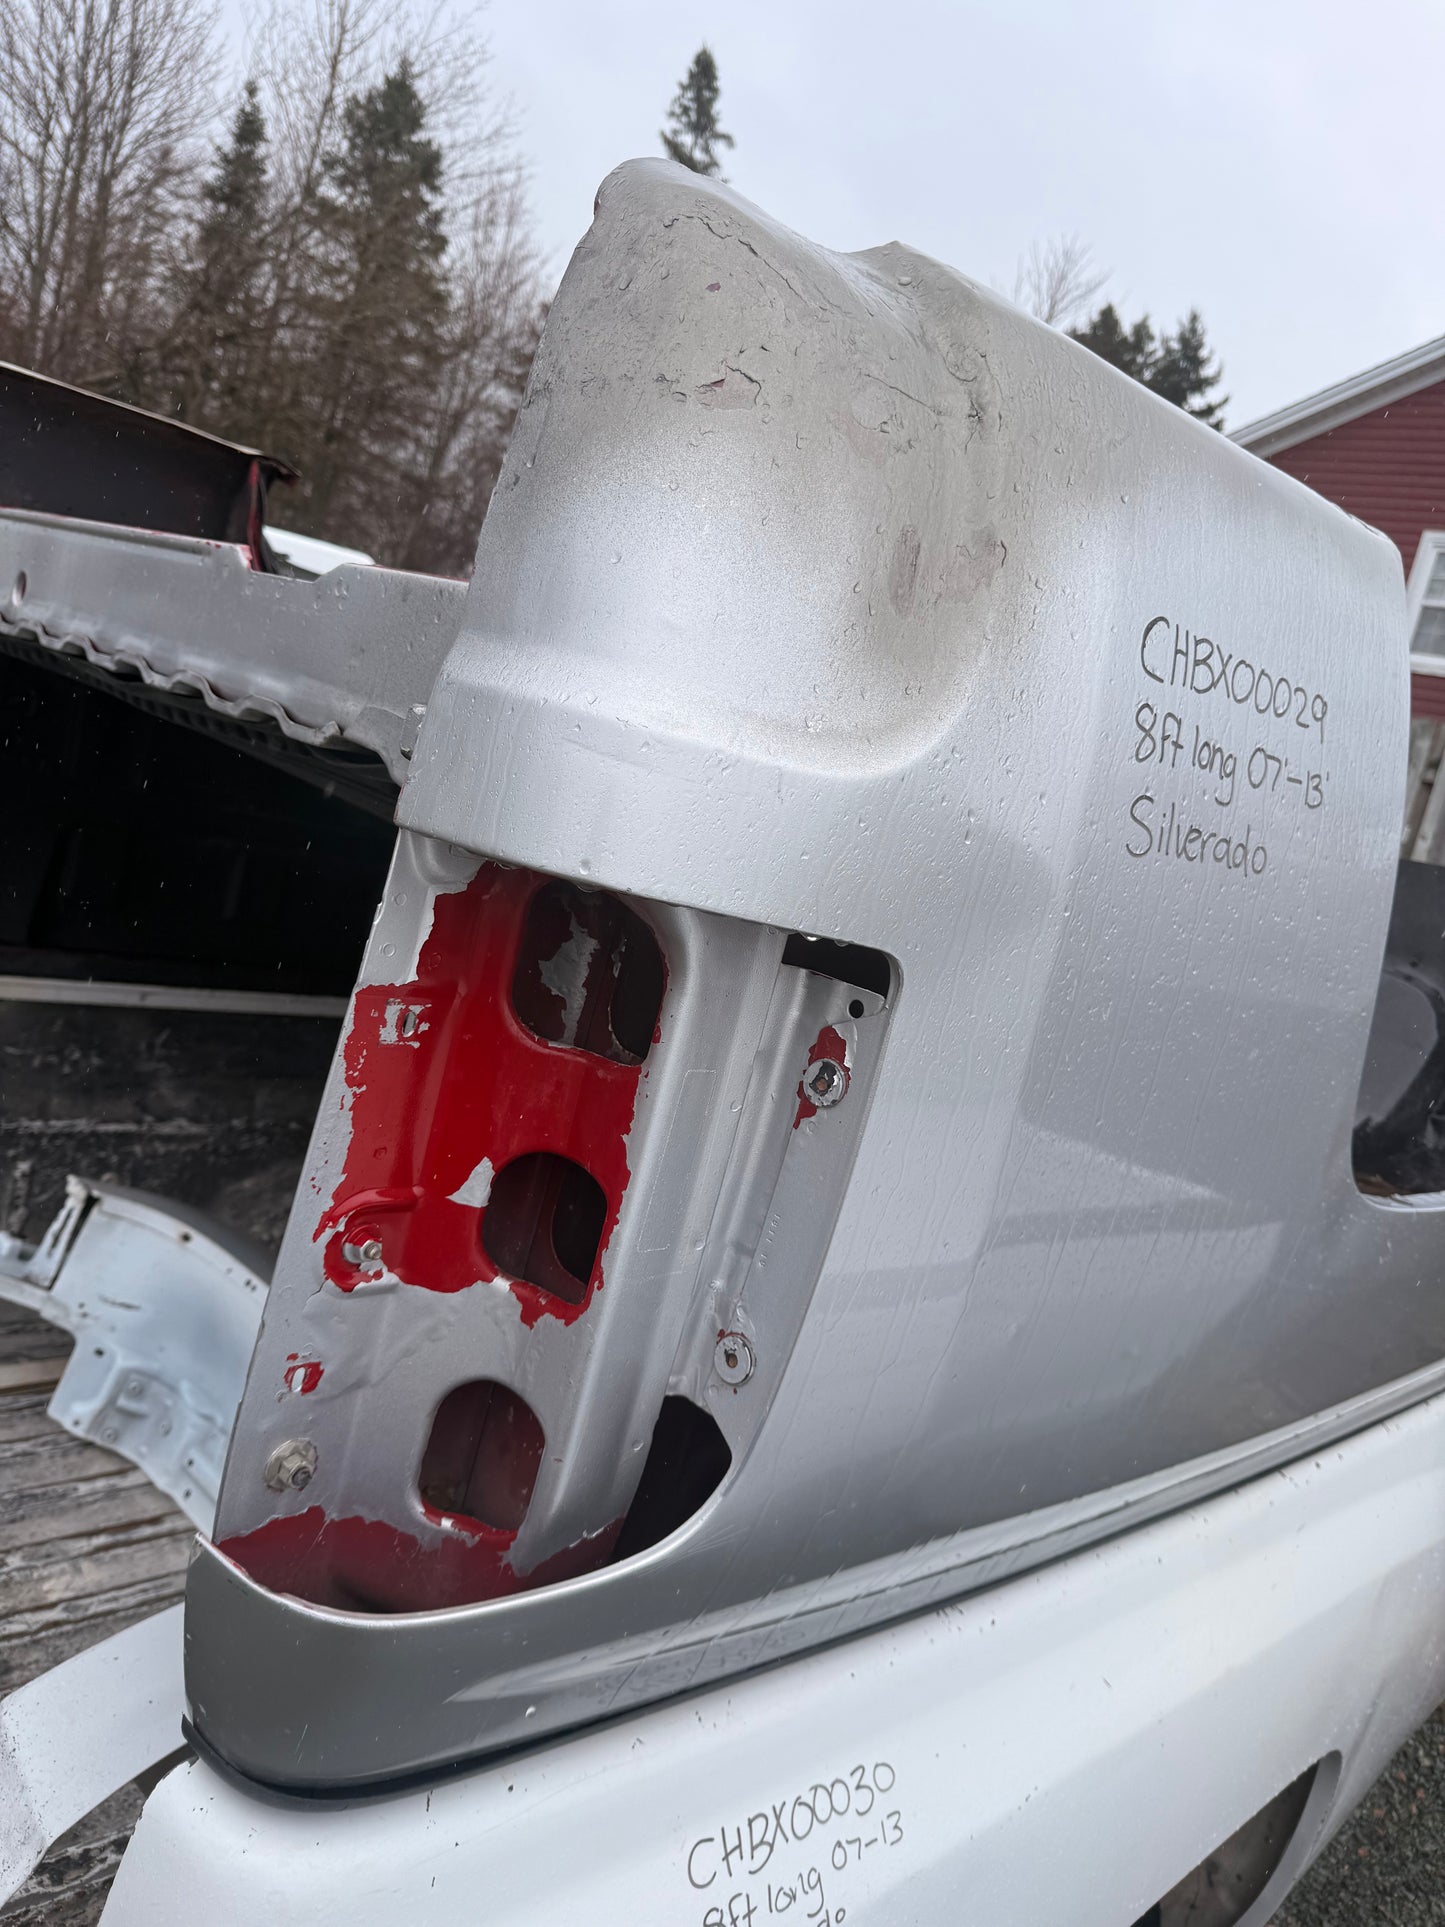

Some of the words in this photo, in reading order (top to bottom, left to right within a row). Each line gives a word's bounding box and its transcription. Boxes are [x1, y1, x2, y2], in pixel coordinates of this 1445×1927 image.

[1140, 615, 1328, 745] CHBX00029
[1134, 702, 1184, 769] 8ft
[1191, 724, 1237, 807] long
[1125, 794, 1268, 878] Silverado
[687, 1761, 896, 1890] CHBX00030
[767, 1866, 825, 1918] long
[831, 1809, 904, 1871] 07-13
